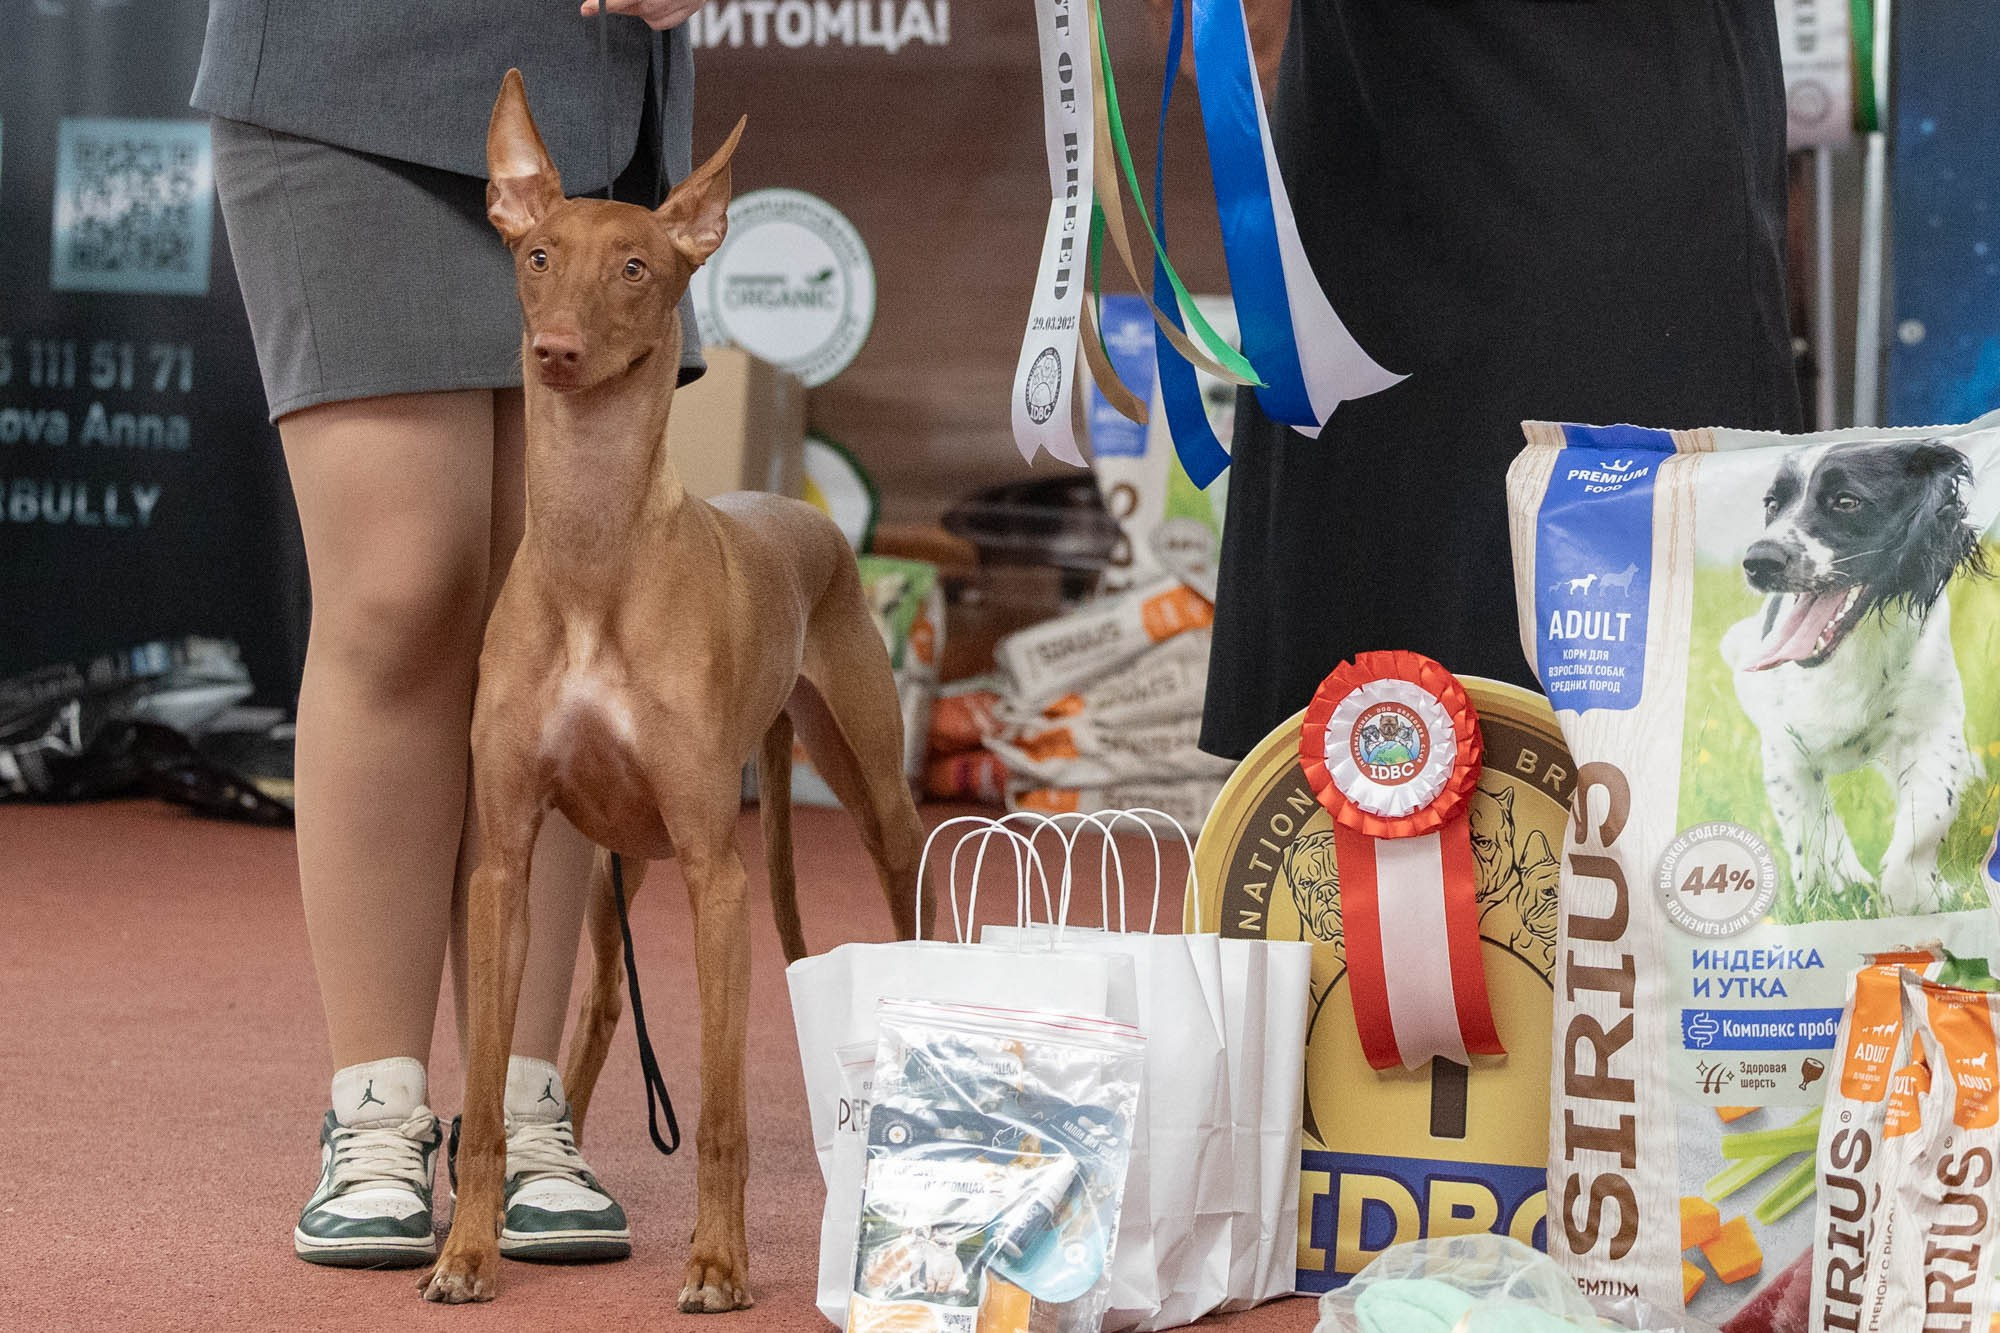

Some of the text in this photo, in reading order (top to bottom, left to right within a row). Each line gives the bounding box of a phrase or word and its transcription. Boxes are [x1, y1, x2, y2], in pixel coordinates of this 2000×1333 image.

[1058, 51, 1075, 113] OF
[1054, 129, 1079, 300] BREED
[80, 402, 192, 450] Anna
[1567, 467, 1649, 484] PREMIUM
[1584, 484, 1623, 494] FOOD
[0, 478, 161, 528] BULLY
[1548, 609, 1632, 642] ADULT
[1562, 648, 1609, 661] КОРМ ДЛЯ
[1548, 664, 1625, 679] ВЗРОСЛЫХ СОБАК
[1550, 680, 1621, 693] СРЕДНИХ ПОРОД
[1369, 762, 1415, 780] IDBC
[1516, 747, 1578, 802] BR
[1660, 824, 1775, 936] ВЫСОКОЕ СОДЕРЖАНИЕ ЖИВОТНЫХ ИНГРЕДИЕНТОВ
[1680, 863, 1755, 896] 44%
[1692, 944, 1825, 973] ИНДЕЙКА
[1693, 977, 1789, 999] И УТКА
[1563, 761, 1638, 1261] SIRIUS
[1722, 1018, 1795, 1039] Комплекс
[1854, 1042, 1891, 1064] ADULT
[1739, 1061, 1787, 1076] Здоровая
[1740, 1077, 1776, 1091] шерсть
[1957, 1073, 1992, 1092] ADULT
